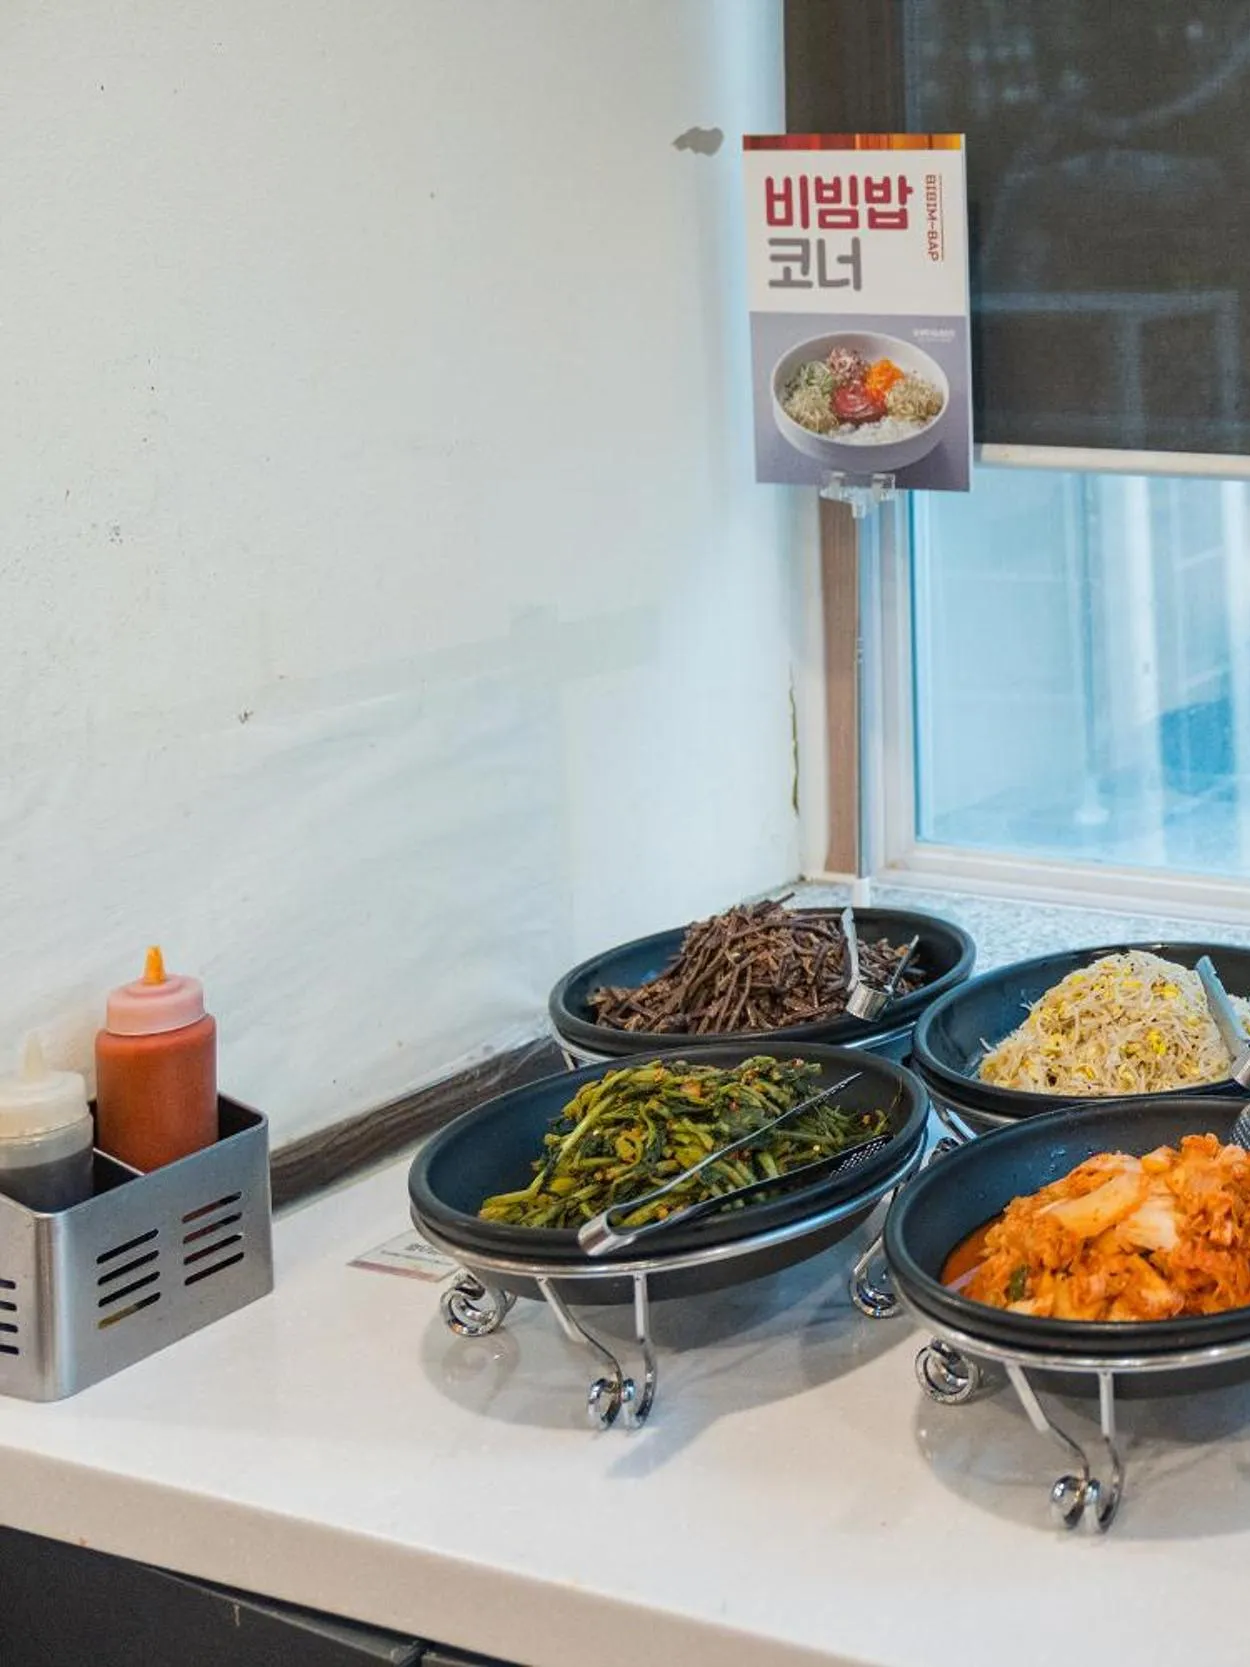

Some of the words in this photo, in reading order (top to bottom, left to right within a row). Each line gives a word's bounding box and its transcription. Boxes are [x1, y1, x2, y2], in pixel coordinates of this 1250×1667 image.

[765, 174, 914, 230] 비빔밥
[925, 173, 940, 262] BIBIM-BAP
[767, 236, 863, 292] 코너
